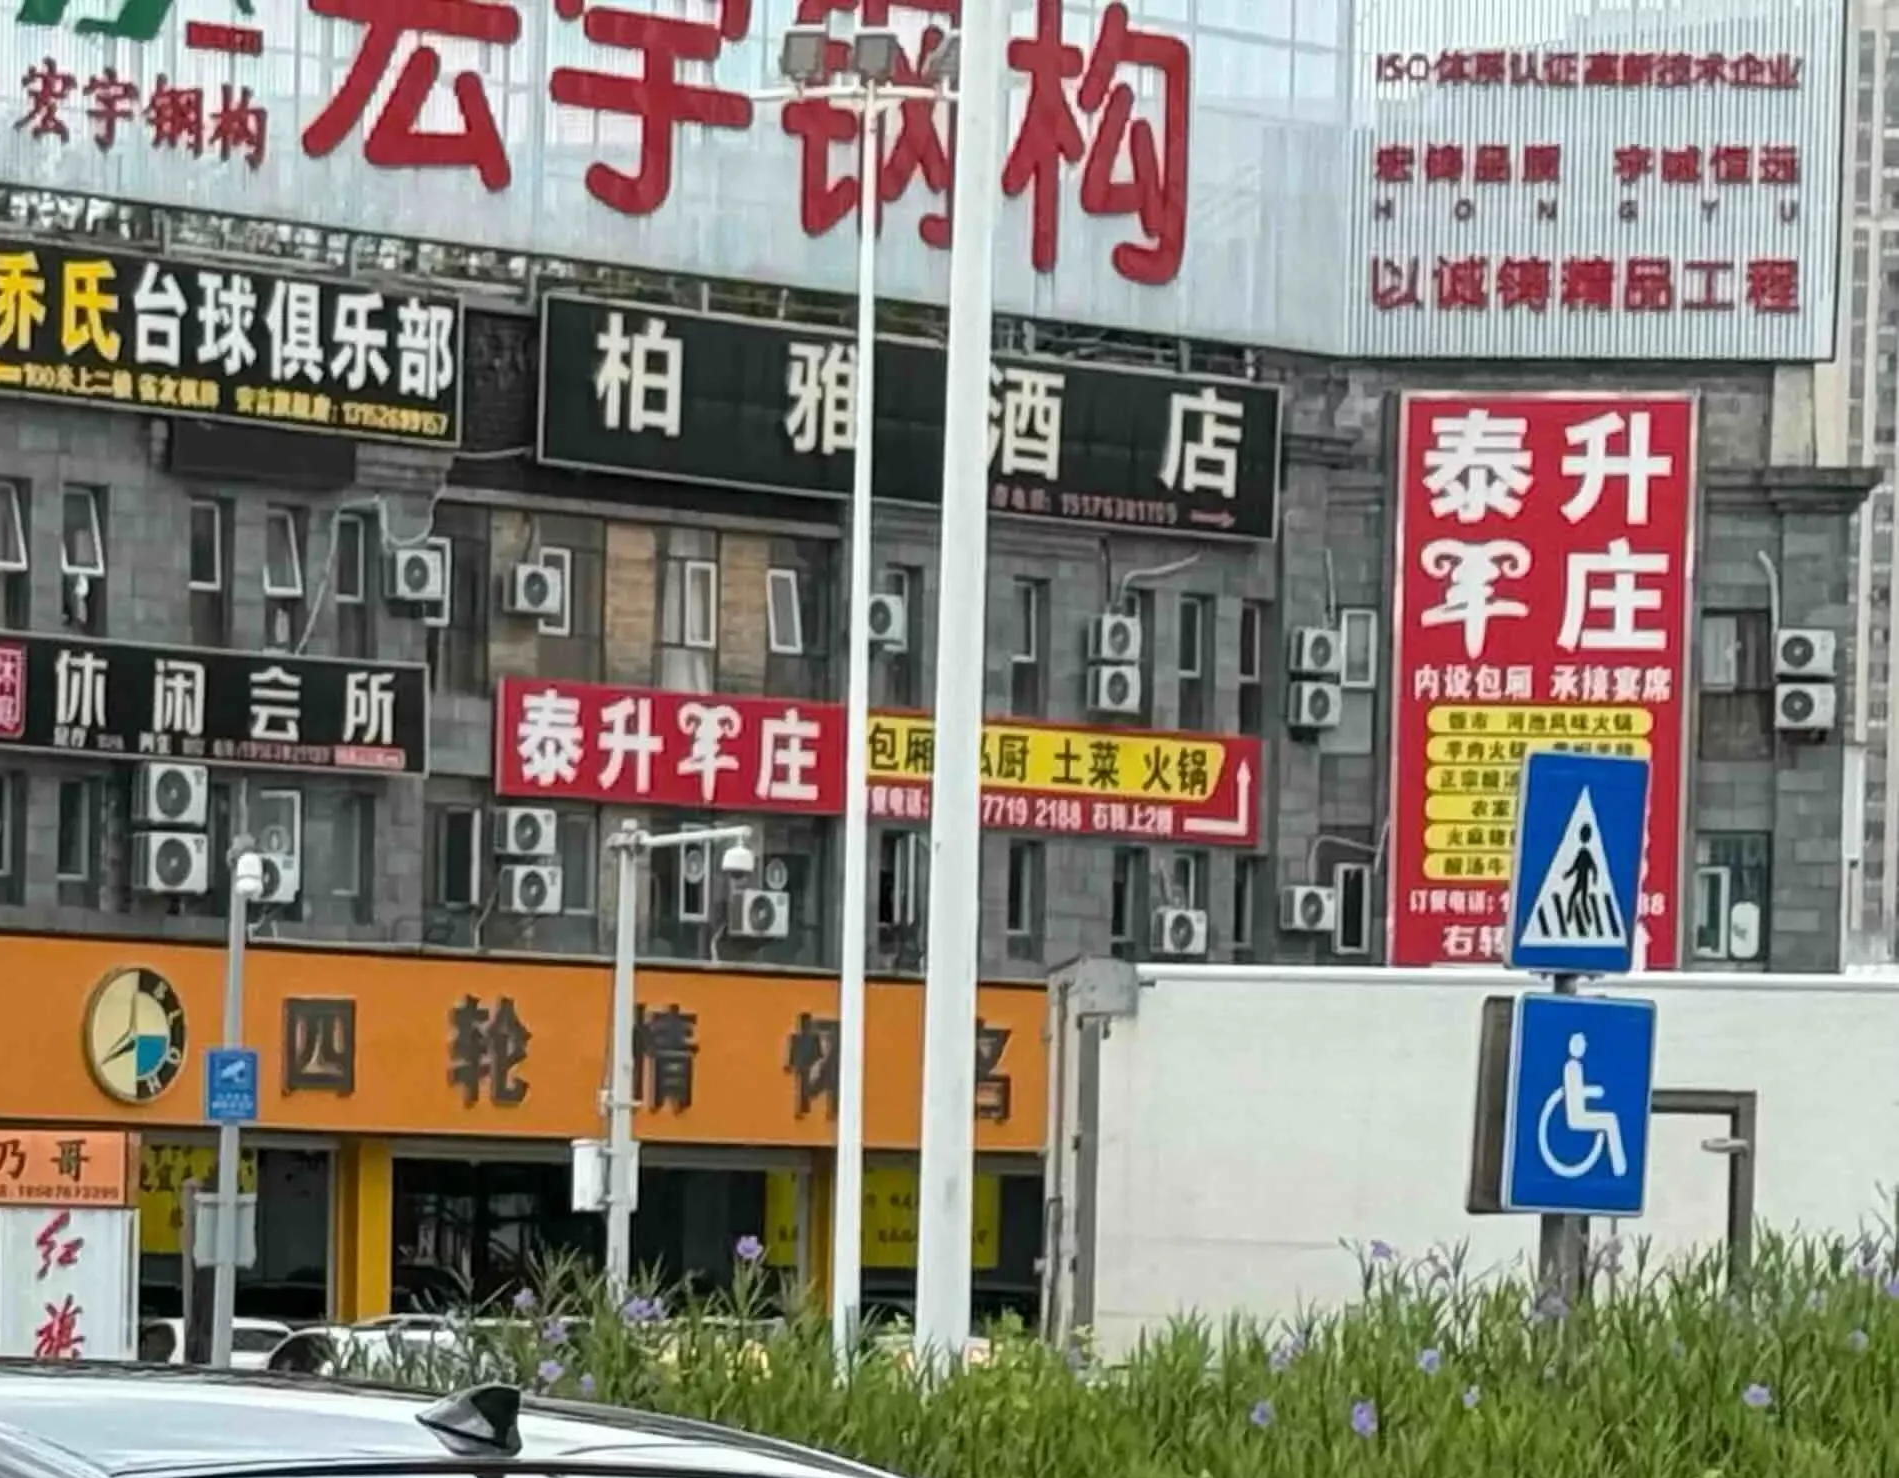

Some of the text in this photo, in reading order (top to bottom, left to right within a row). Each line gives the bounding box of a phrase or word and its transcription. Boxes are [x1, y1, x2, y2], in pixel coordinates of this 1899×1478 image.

[593, 314, 1245, 500] 柏雅酒店
[1422, 408, 1673, 525] 泰升
[54, 648, 397, 746] 休闲会所
[1051, 739, 1120, 788] 土菜
[1141, 746, 1209, 796] 火锅
